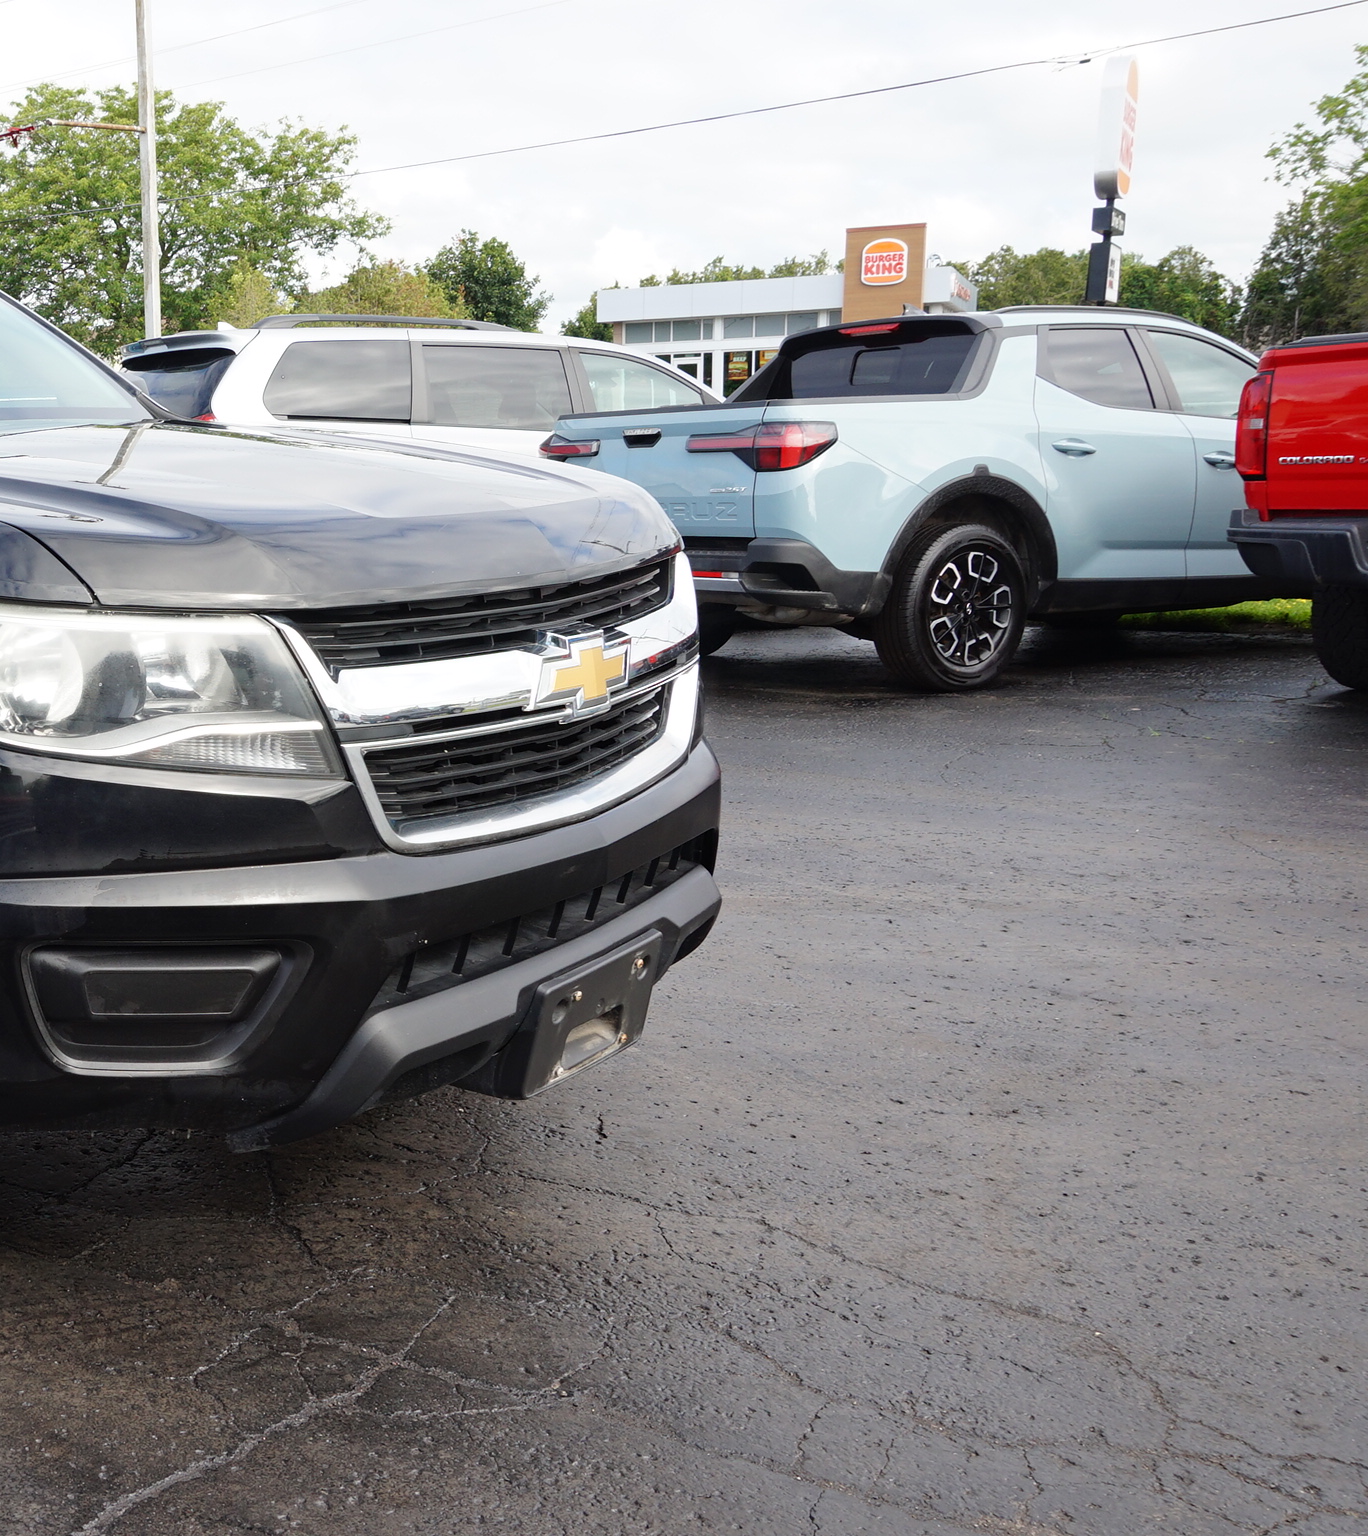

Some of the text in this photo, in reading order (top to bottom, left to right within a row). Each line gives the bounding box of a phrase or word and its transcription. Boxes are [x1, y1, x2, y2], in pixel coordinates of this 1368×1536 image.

[864, 253, 905, 264] BURGER
[863, 262, 904, 276] KING
[1278, 455, 1355, 465] COLORADO
